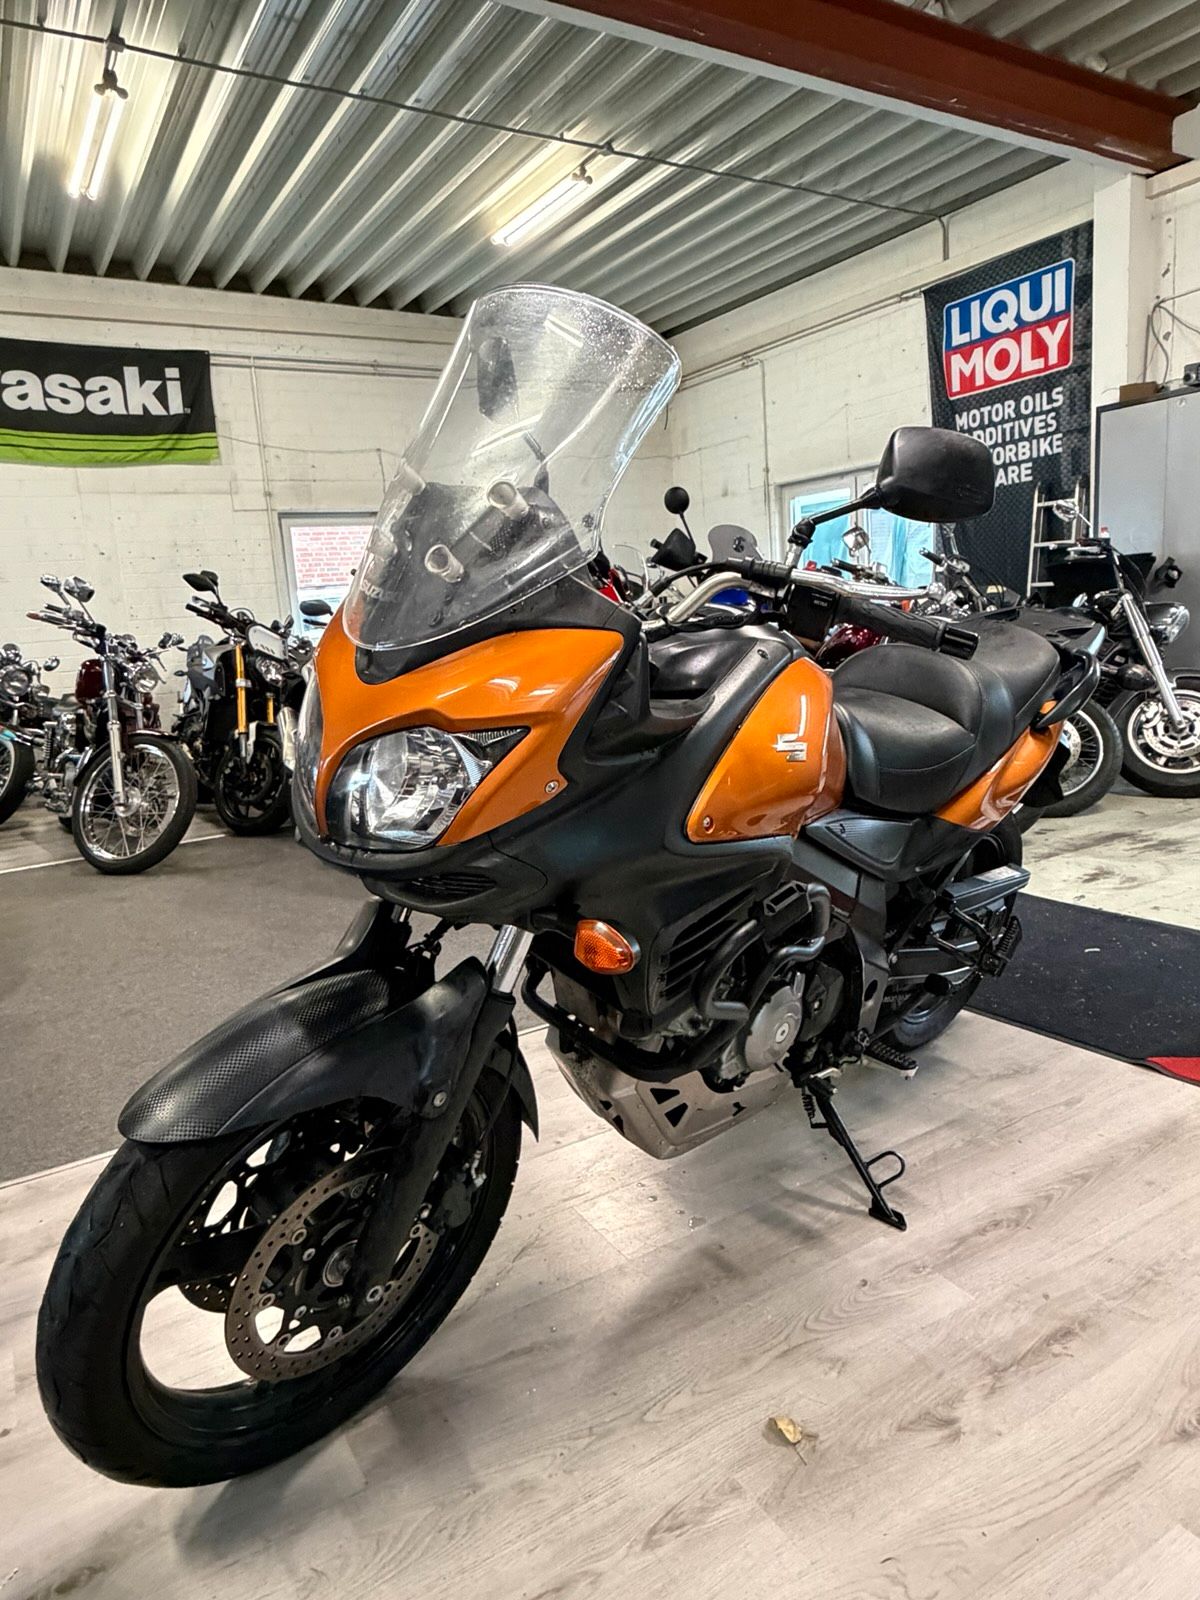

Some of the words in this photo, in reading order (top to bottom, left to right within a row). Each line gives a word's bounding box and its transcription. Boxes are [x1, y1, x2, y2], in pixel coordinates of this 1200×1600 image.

[950, 267, 1067, 347] LIQUI
[950, 318, 1070, 393] MOLY
[0, 366, 185, 416] asaki
[955, 399, 1017, 431] MOTOR
[1020, 385, 1064, 415] OILS
[964, 411, 1057, 446] DITIVES
[991, 432, 1064, 466] ORBIKE
[995, 462, 1033, 488] ARE
